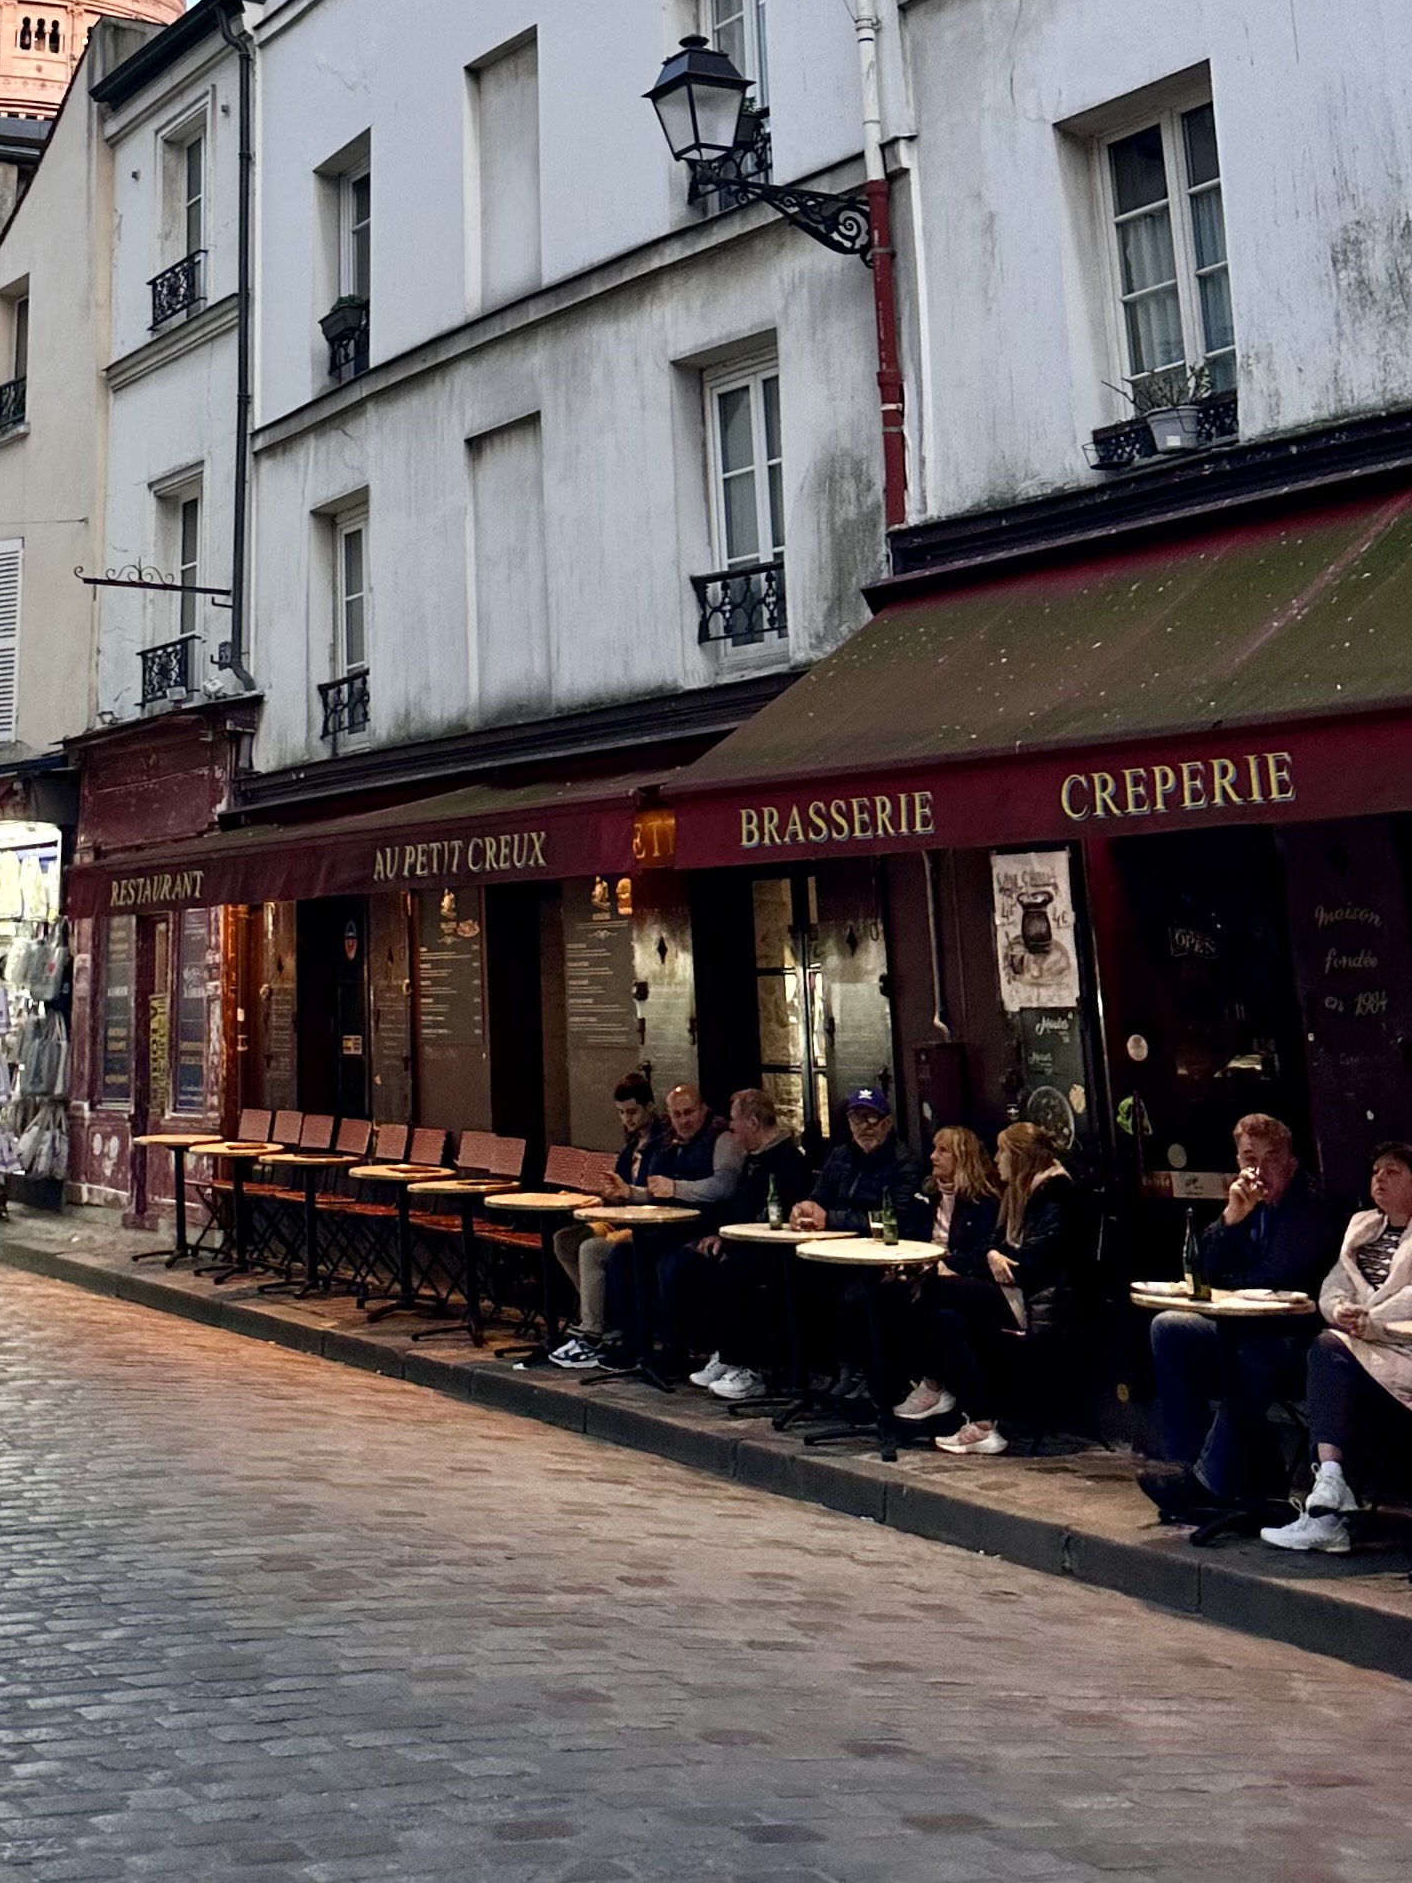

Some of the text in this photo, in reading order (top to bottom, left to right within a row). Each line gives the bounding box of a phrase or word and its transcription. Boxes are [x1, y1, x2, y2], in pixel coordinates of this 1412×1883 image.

[1061, 751, 1297, 821] CREPERIE
[738, 791, 938, 849] BRASSERIE
[373, 831, 548, 882] AU PETIT CREUX
[109, 870, 204, 907] RESTAURANT
